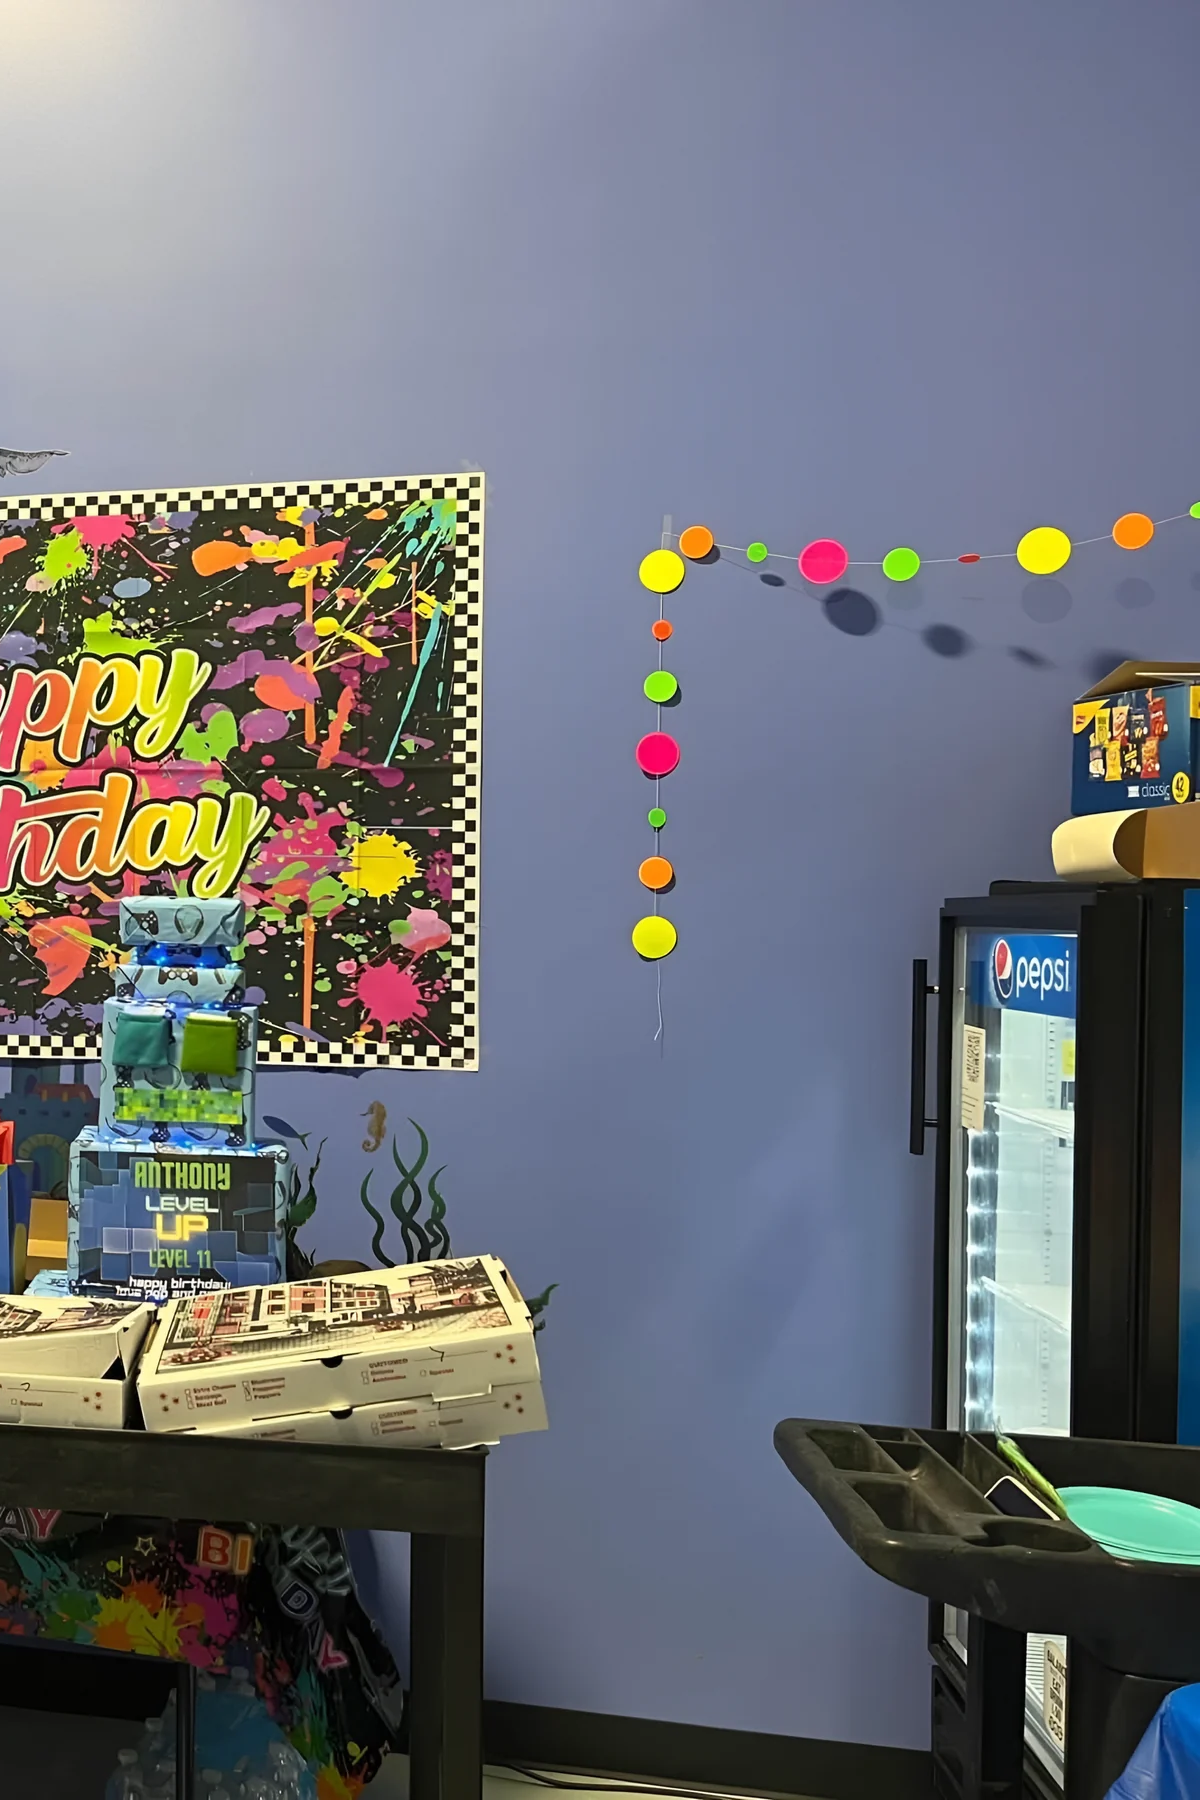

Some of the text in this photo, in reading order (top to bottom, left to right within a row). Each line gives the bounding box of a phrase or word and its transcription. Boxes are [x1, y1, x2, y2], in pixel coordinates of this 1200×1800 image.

[1141, 782, 1171, 798] classic
[1175, 776, 1185, 792] 42
[1016, 949, 1070, 1001] pepsi
[134, 1161, 231, 1191] ANTHONY
[145, 1195, 219, 1213] LEVEL
[155, 1213, 209, 1242] UP
[149, 1249, 212, 1269] LEVEL 11
[129, 1275, 167, 1290] happy
